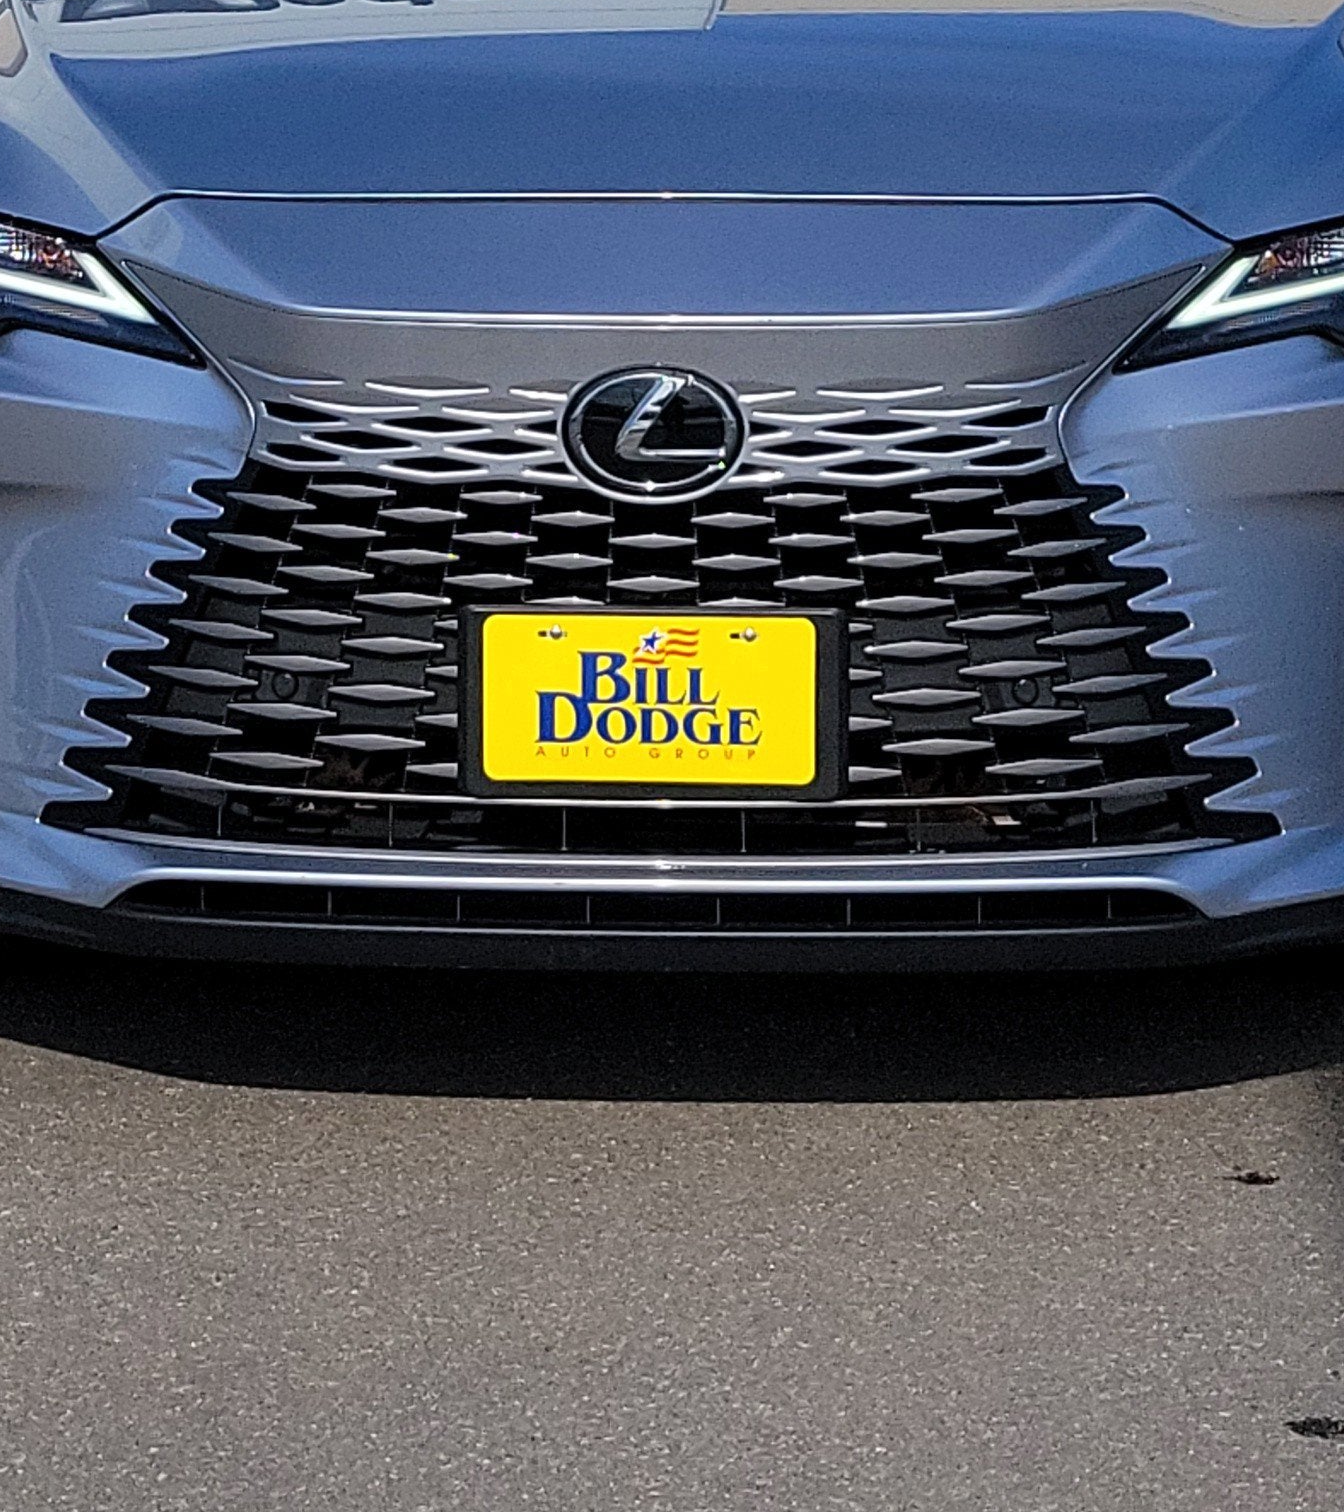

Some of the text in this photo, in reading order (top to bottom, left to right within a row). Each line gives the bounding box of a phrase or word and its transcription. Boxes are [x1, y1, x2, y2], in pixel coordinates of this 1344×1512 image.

[577, 650, 721, 705] BILL
[535, 690, 763, 746] DODGE
[536, 746, 756, 760] AUTO GROUP
